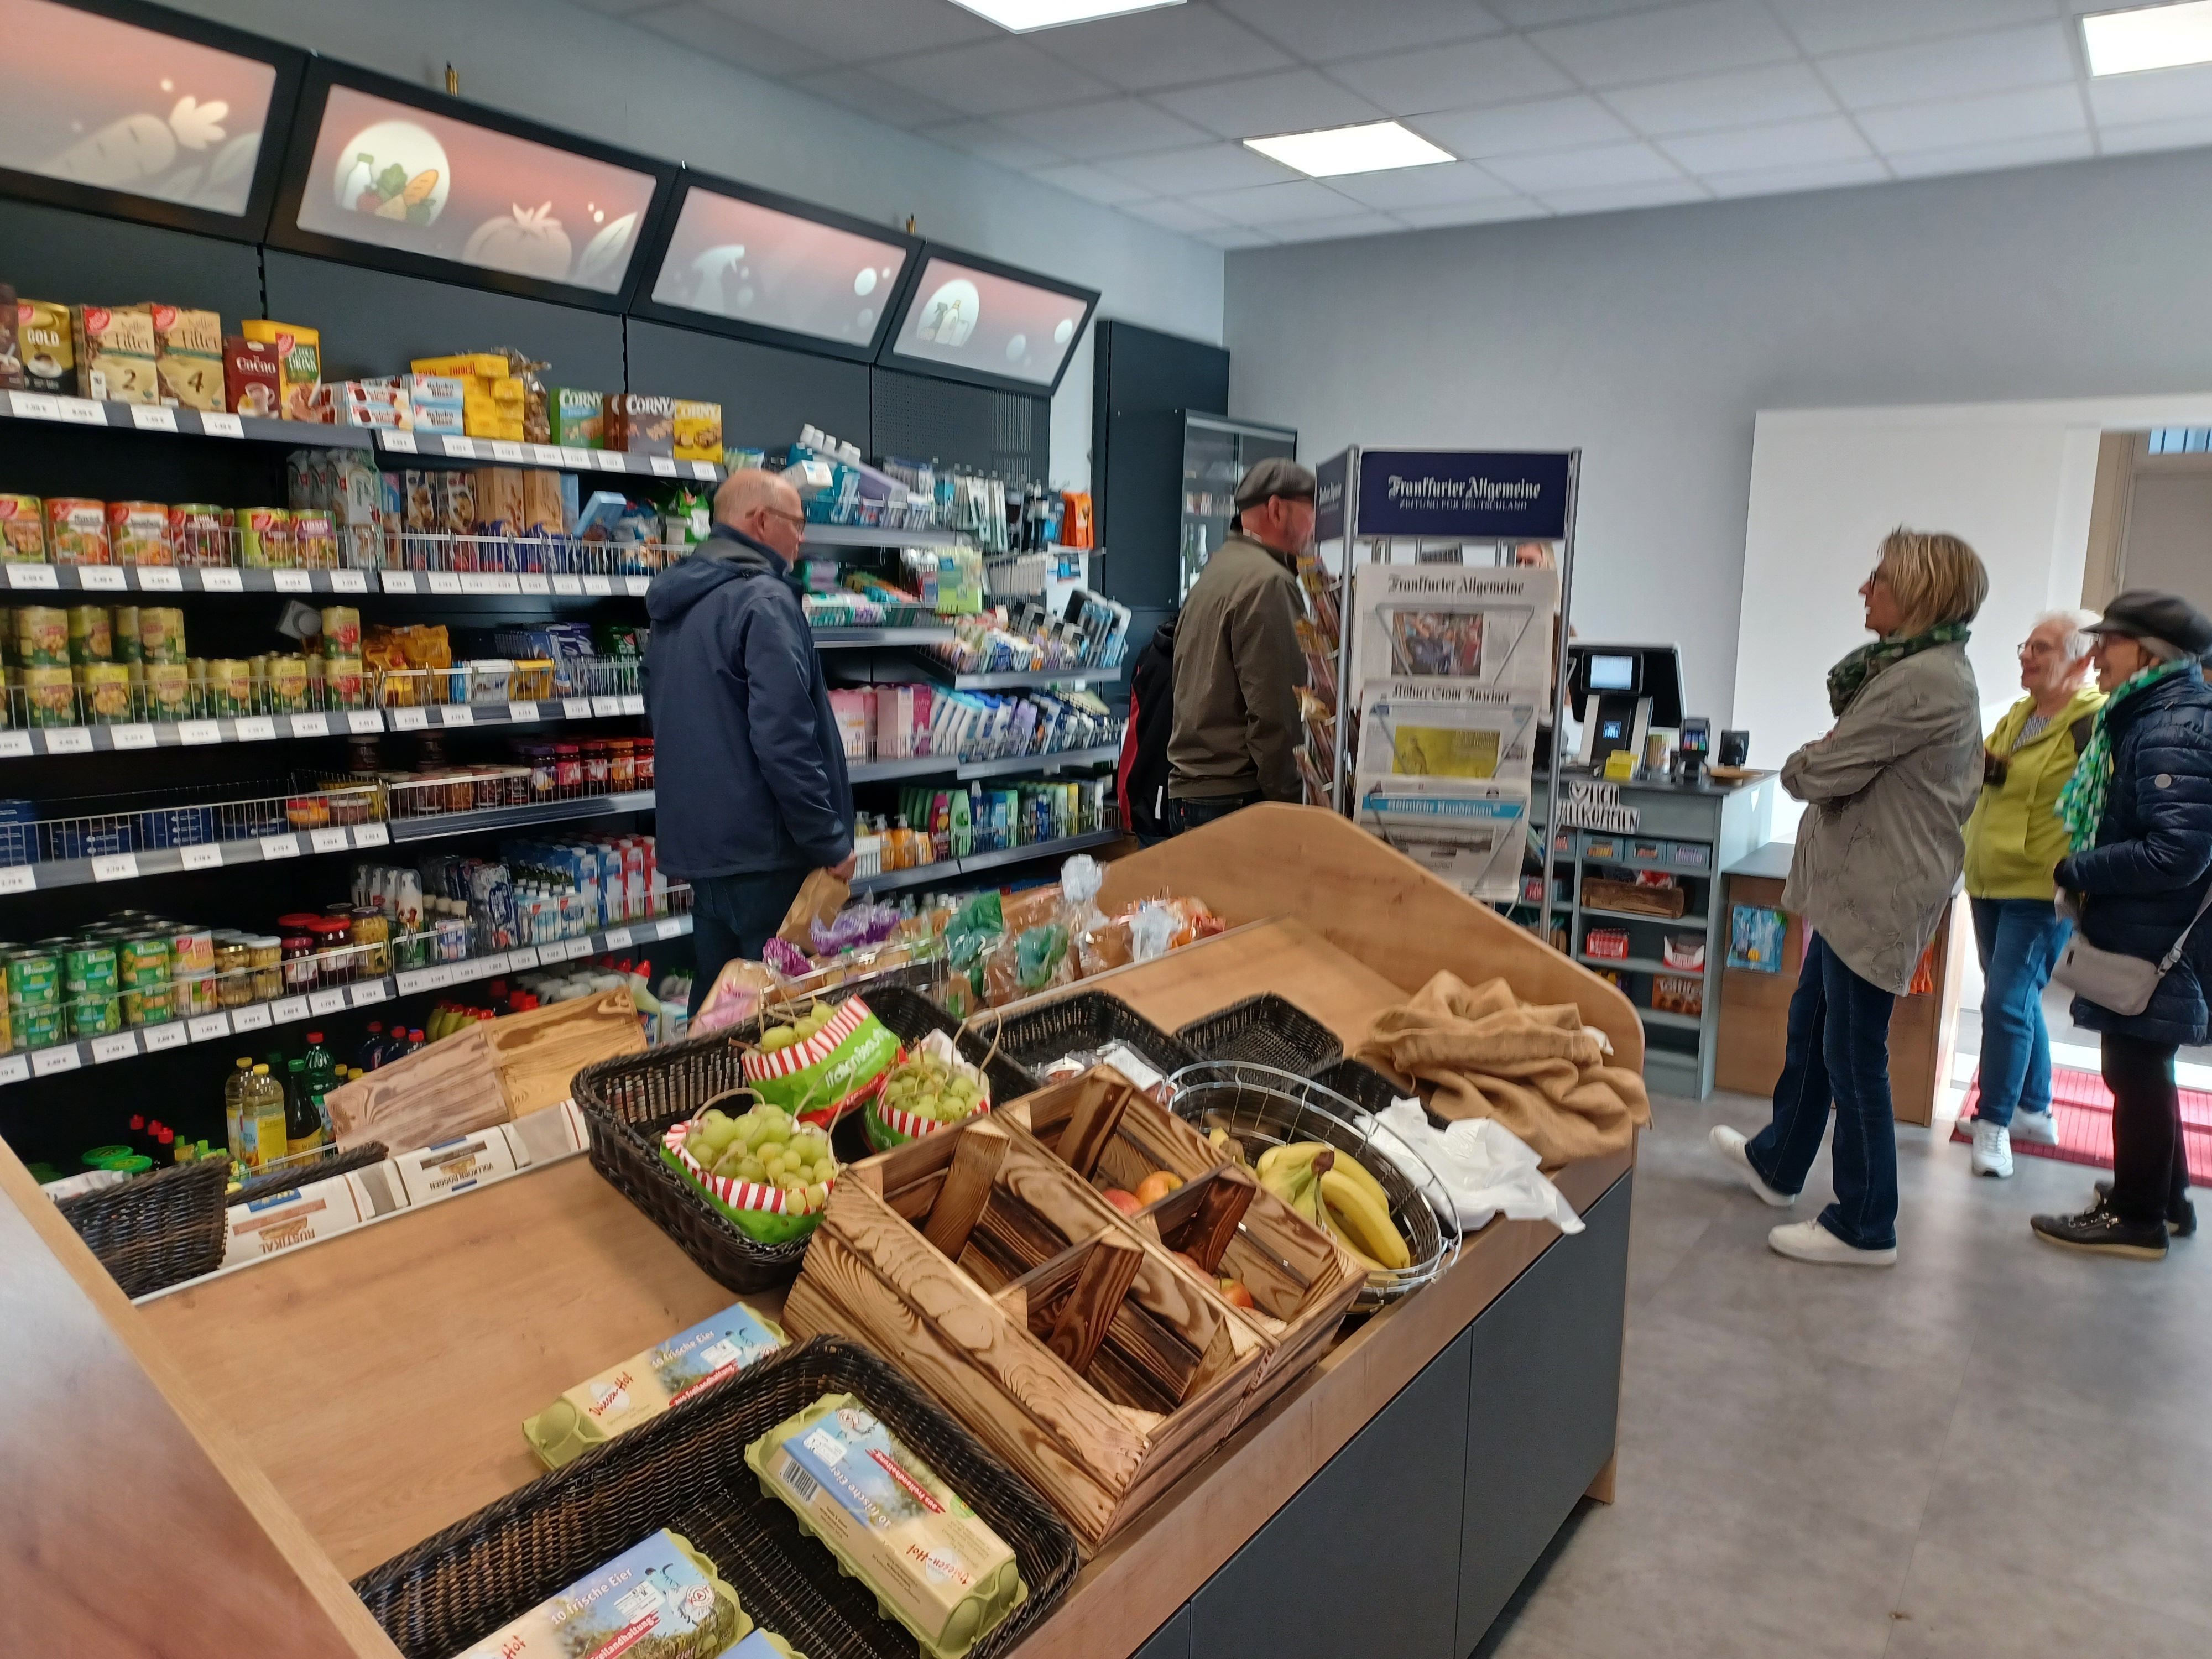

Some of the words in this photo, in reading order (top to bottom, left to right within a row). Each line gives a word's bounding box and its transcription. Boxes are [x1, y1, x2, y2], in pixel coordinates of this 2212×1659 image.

[28, 328, 59, 346] GOLD
[122, 368, 136, 390] 2
[187, 370, 204, 393] 4
[559, 387, 603, 408] CORNY
[626, 393, 671, 416] CORNY
[1388, 474, 1465, 501] Frankfurter
[1466, 476, 1540, 502] Allgemeine
[1457, 575, 1524, 597] Allgemeine
[261, 1228, 316, 1254] RUSTIKAL
[551, 1610, 567, 1625] 10
[567, 1583, 609, 1615] frische
[608, 1567, 633, 1587] Eier
